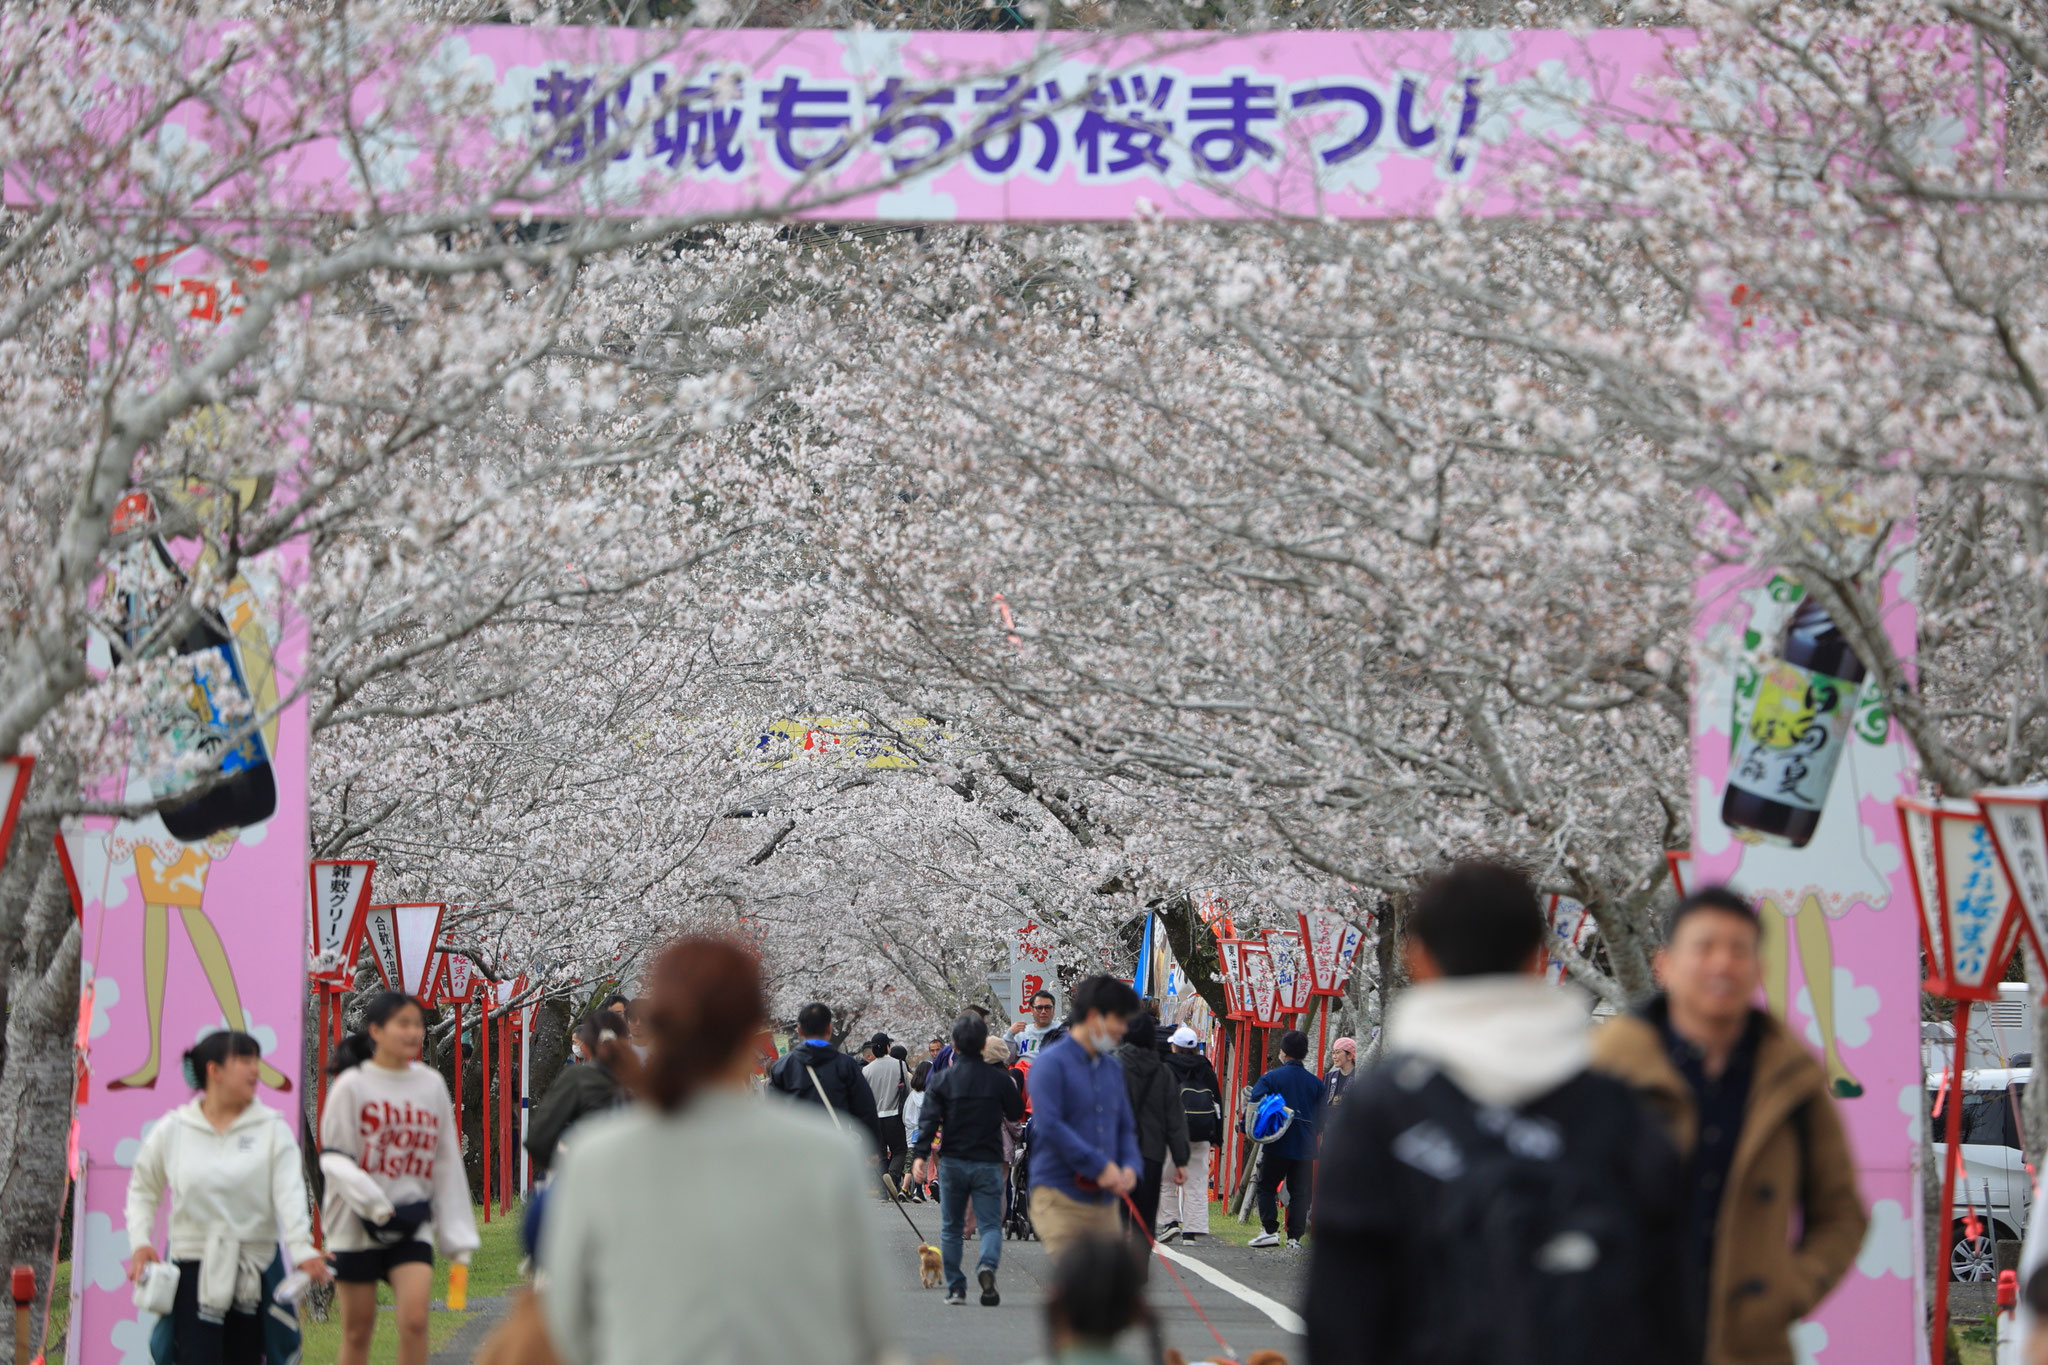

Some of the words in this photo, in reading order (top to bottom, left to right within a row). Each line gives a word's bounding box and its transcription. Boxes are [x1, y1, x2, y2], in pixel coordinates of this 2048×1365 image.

[532, 70, 1481, 174] 都城もちお桜まつり
